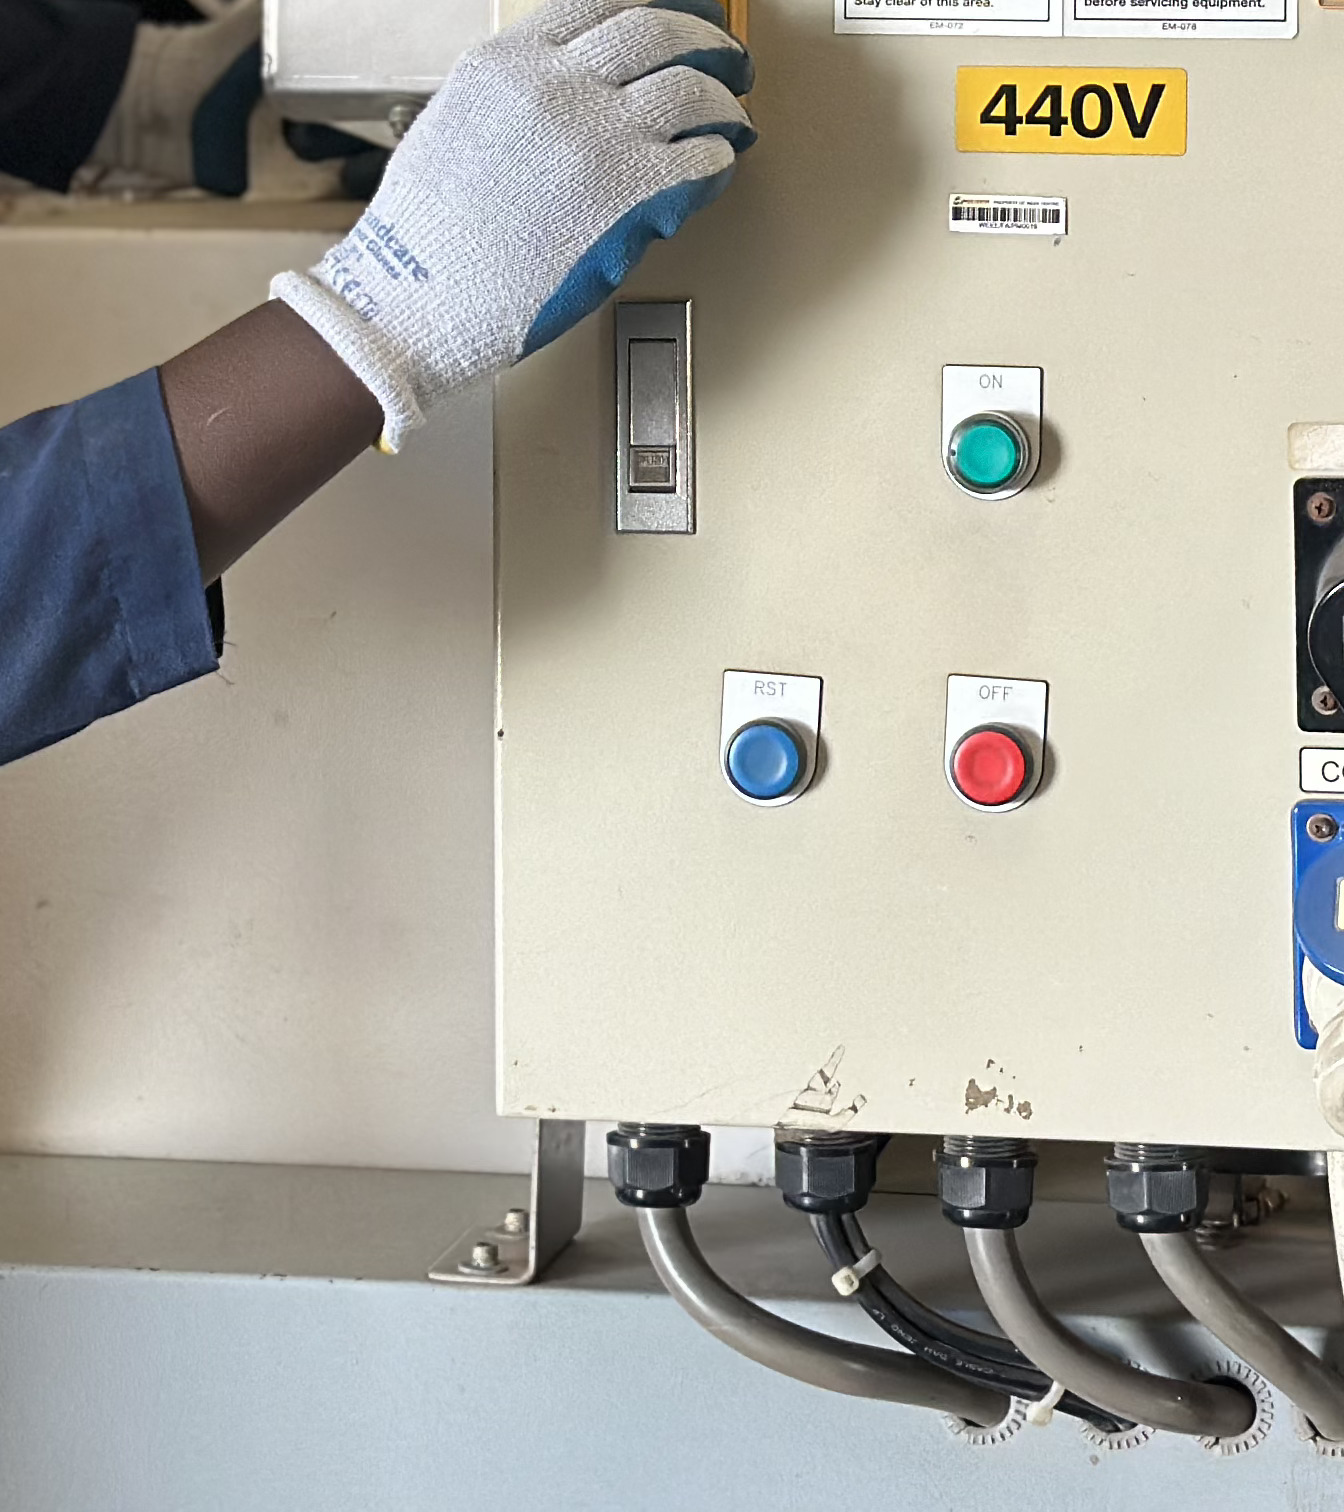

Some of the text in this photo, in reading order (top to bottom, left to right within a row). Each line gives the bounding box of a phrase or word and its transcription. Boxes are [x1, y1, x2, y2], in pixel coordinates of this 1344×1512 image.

[979, 82, 1167, 139] 440V
[978, 374, 1004, 389] ON
[753, 680, 788, 697] RST
[978, 684, 1014, 701] OFF
